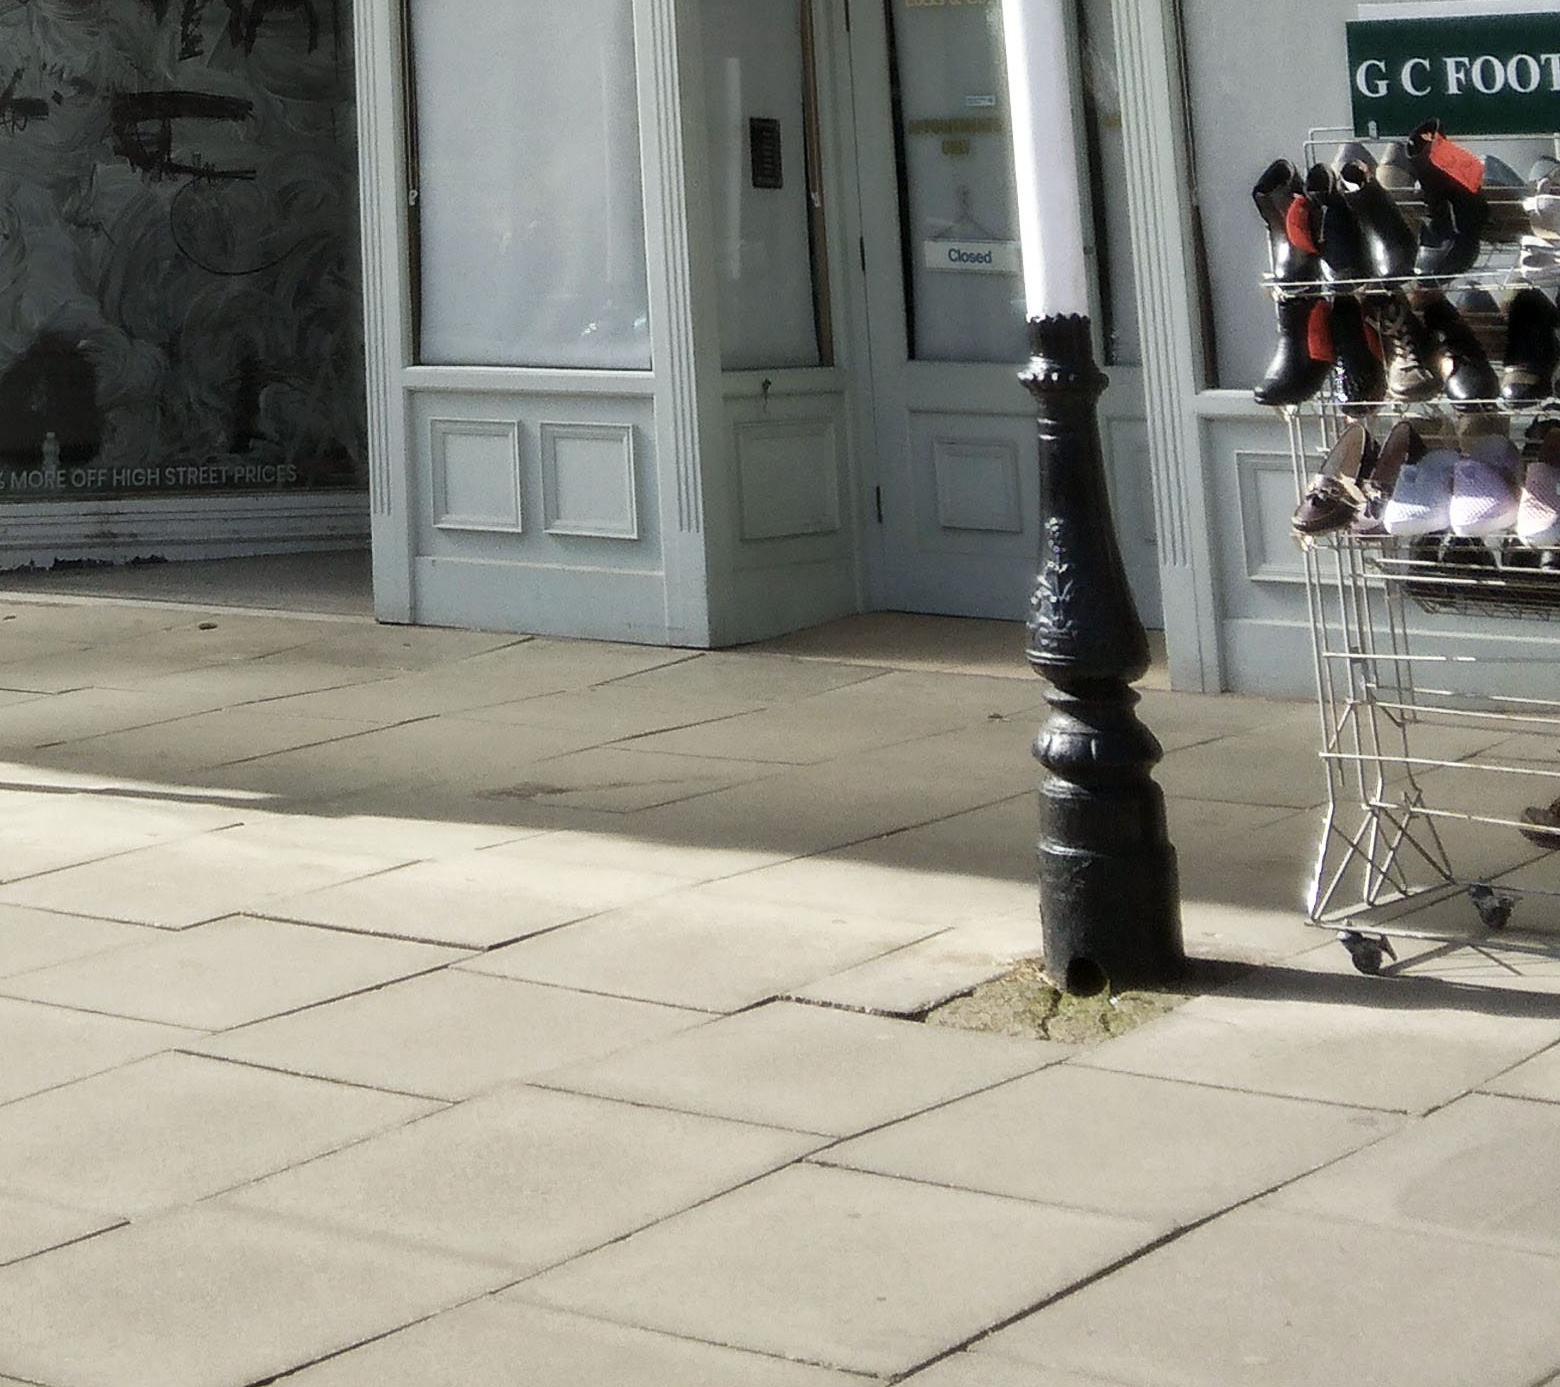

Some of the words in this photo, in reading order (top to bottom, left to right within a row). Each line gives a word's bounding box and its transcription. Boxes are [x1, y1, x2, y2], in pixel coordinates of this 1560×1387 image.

[1356, 59, 1390, 98] G
[1400, 57, 1432, 96] C
[948, 247, 992, 265] Closed
[10, 470, 66, 489] MORE
[71, 468, 107, 488] OFF
[113, 467, 161, 487] HIGH
[164, 465, 230, 486] STREET
[234, 463, 297, 484] PRICES
